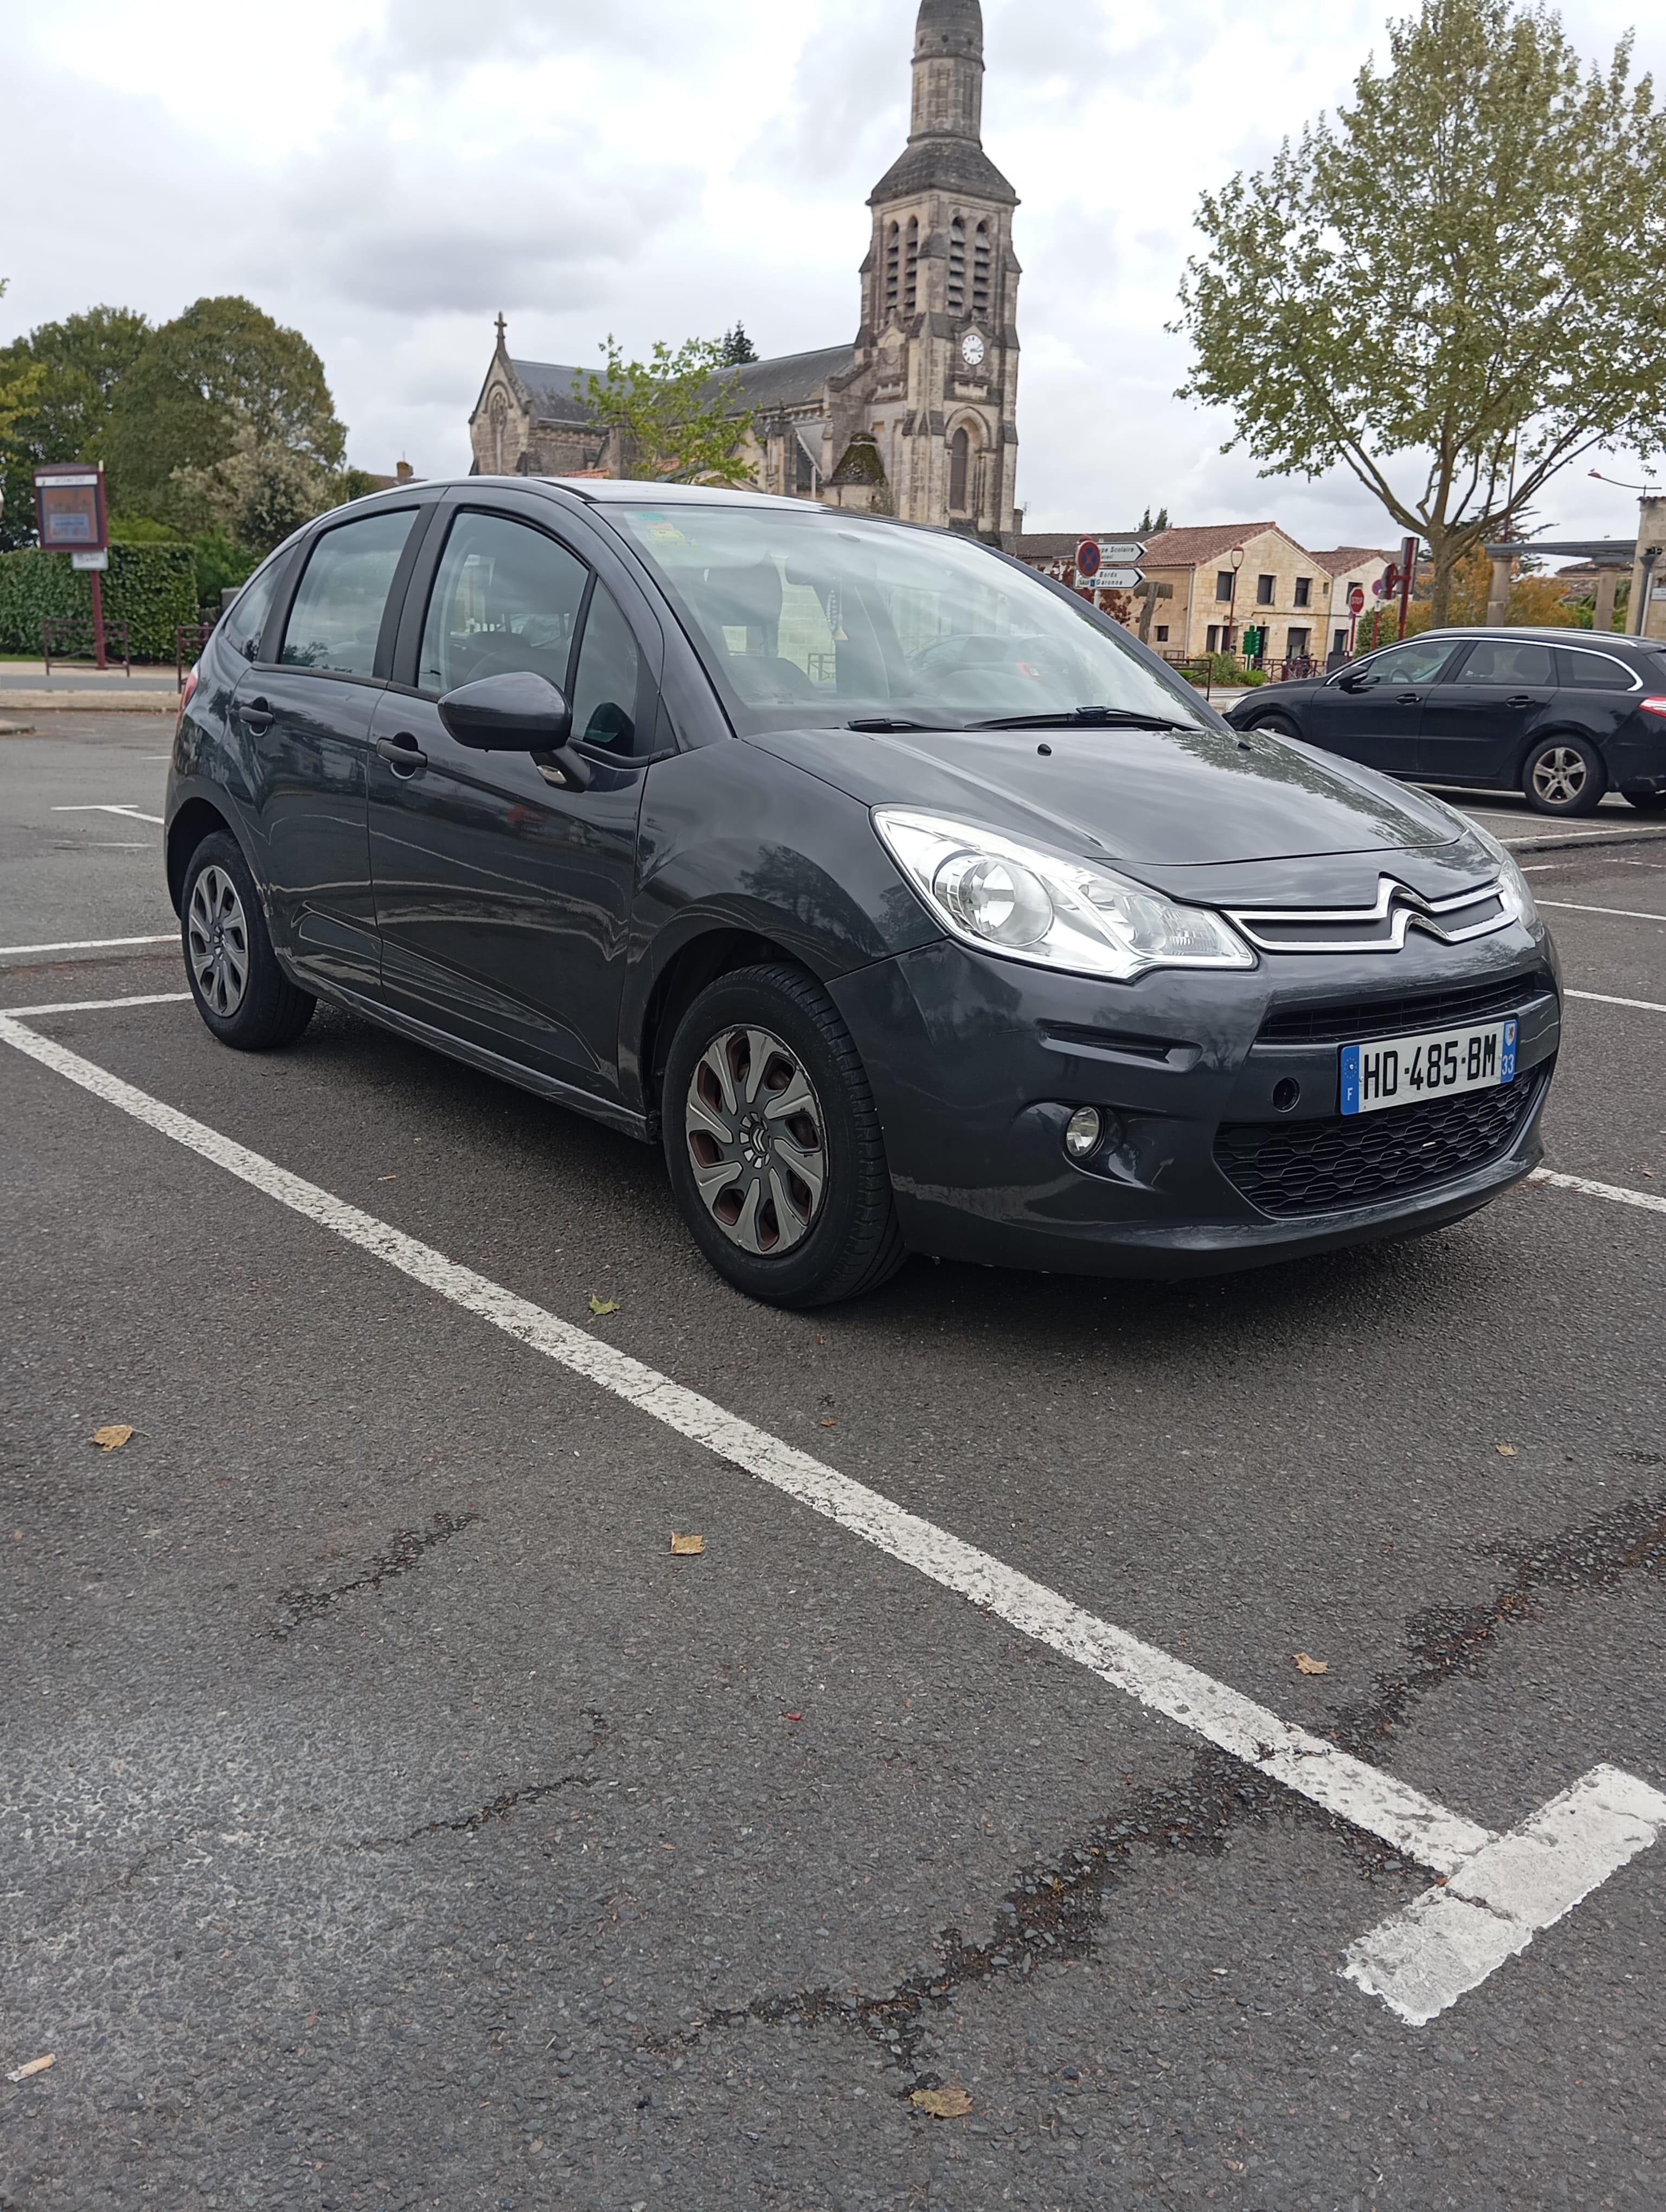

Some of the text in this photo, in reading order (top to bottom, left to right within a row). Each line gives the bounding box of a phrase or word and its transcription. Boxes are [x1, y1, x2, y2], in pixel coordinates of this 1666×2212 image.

[1351, 596, 1363, 605] STOP
[1501, 1054, 1514, 1075] 33
[1347, 1088, 1354, 1101] F
